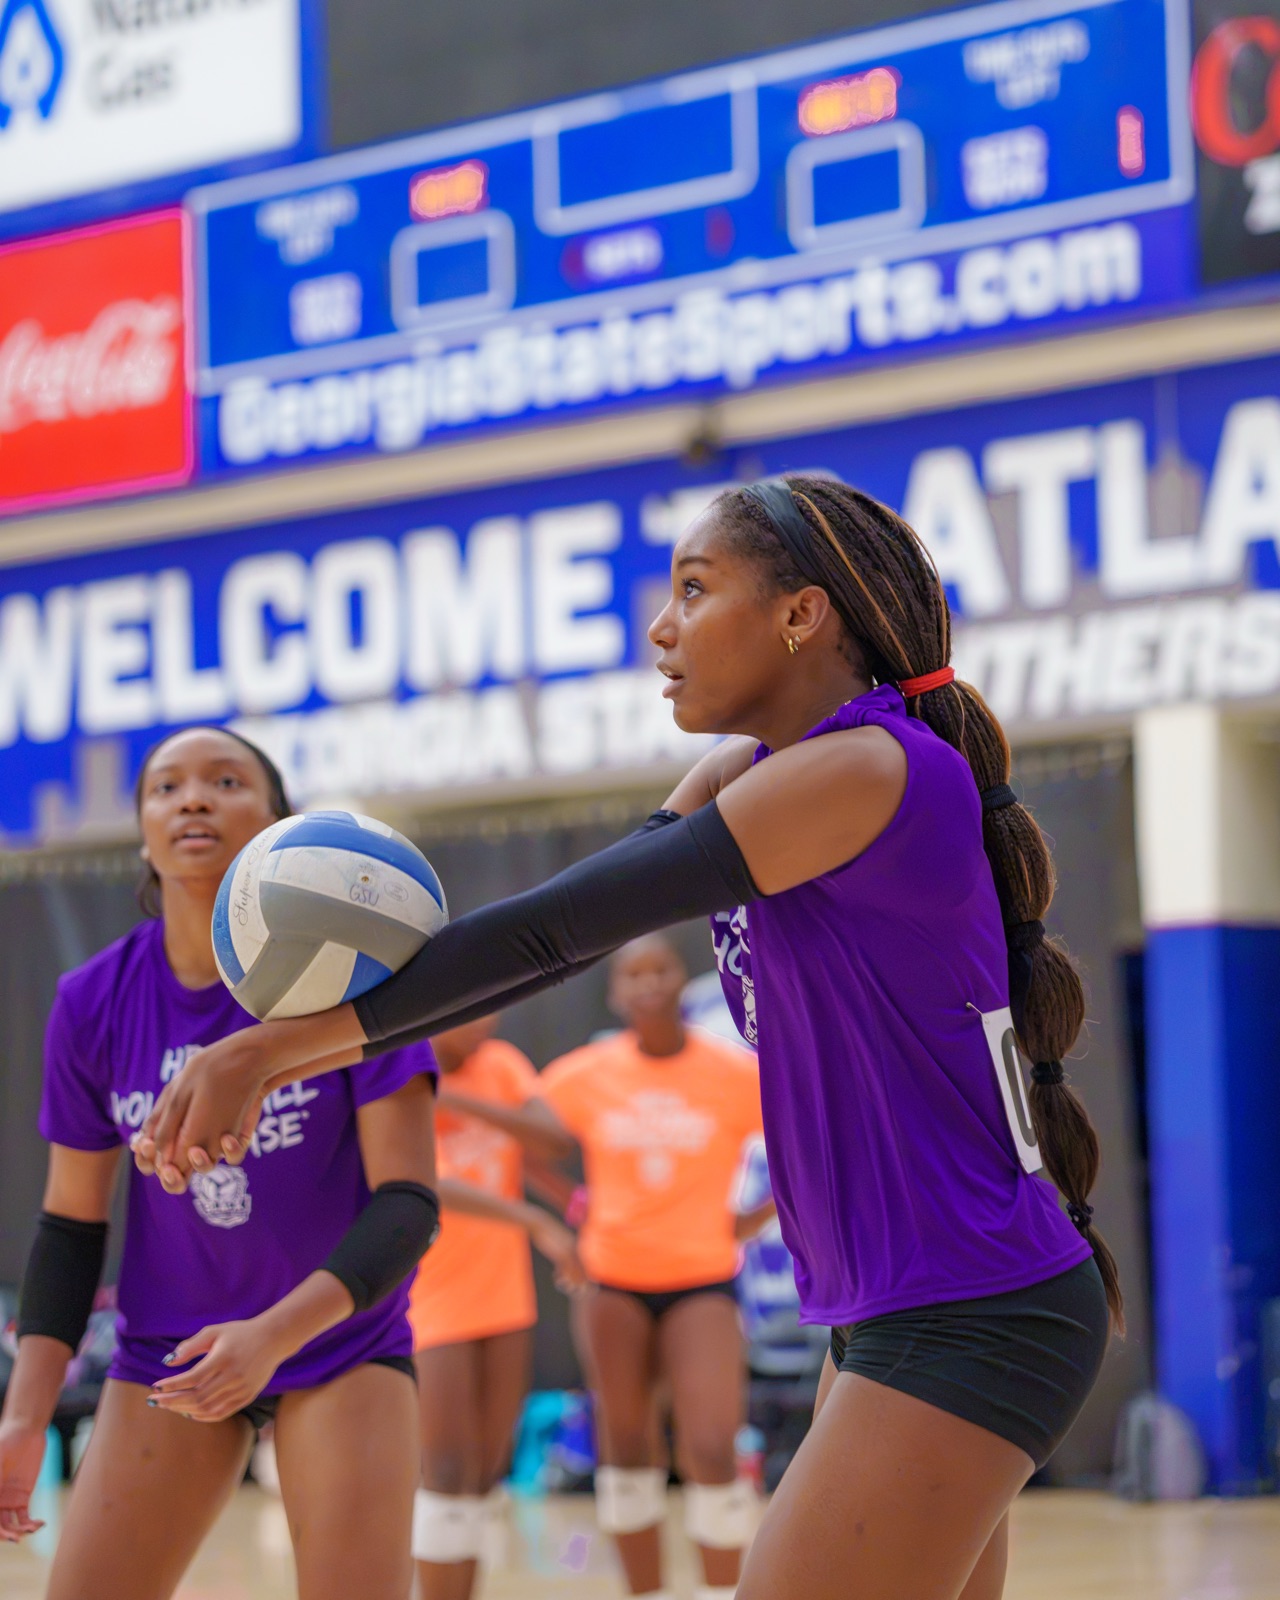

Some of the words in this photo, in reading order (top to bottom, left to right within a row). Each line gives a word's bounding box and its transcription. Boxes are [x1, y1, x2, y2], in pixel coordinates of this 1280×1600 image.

[219, 223, 1141, 463] GeorgiaStateSports.com
[0, 501, 626, 746] WELCOME
[349, 884, 380, 907] GSU
